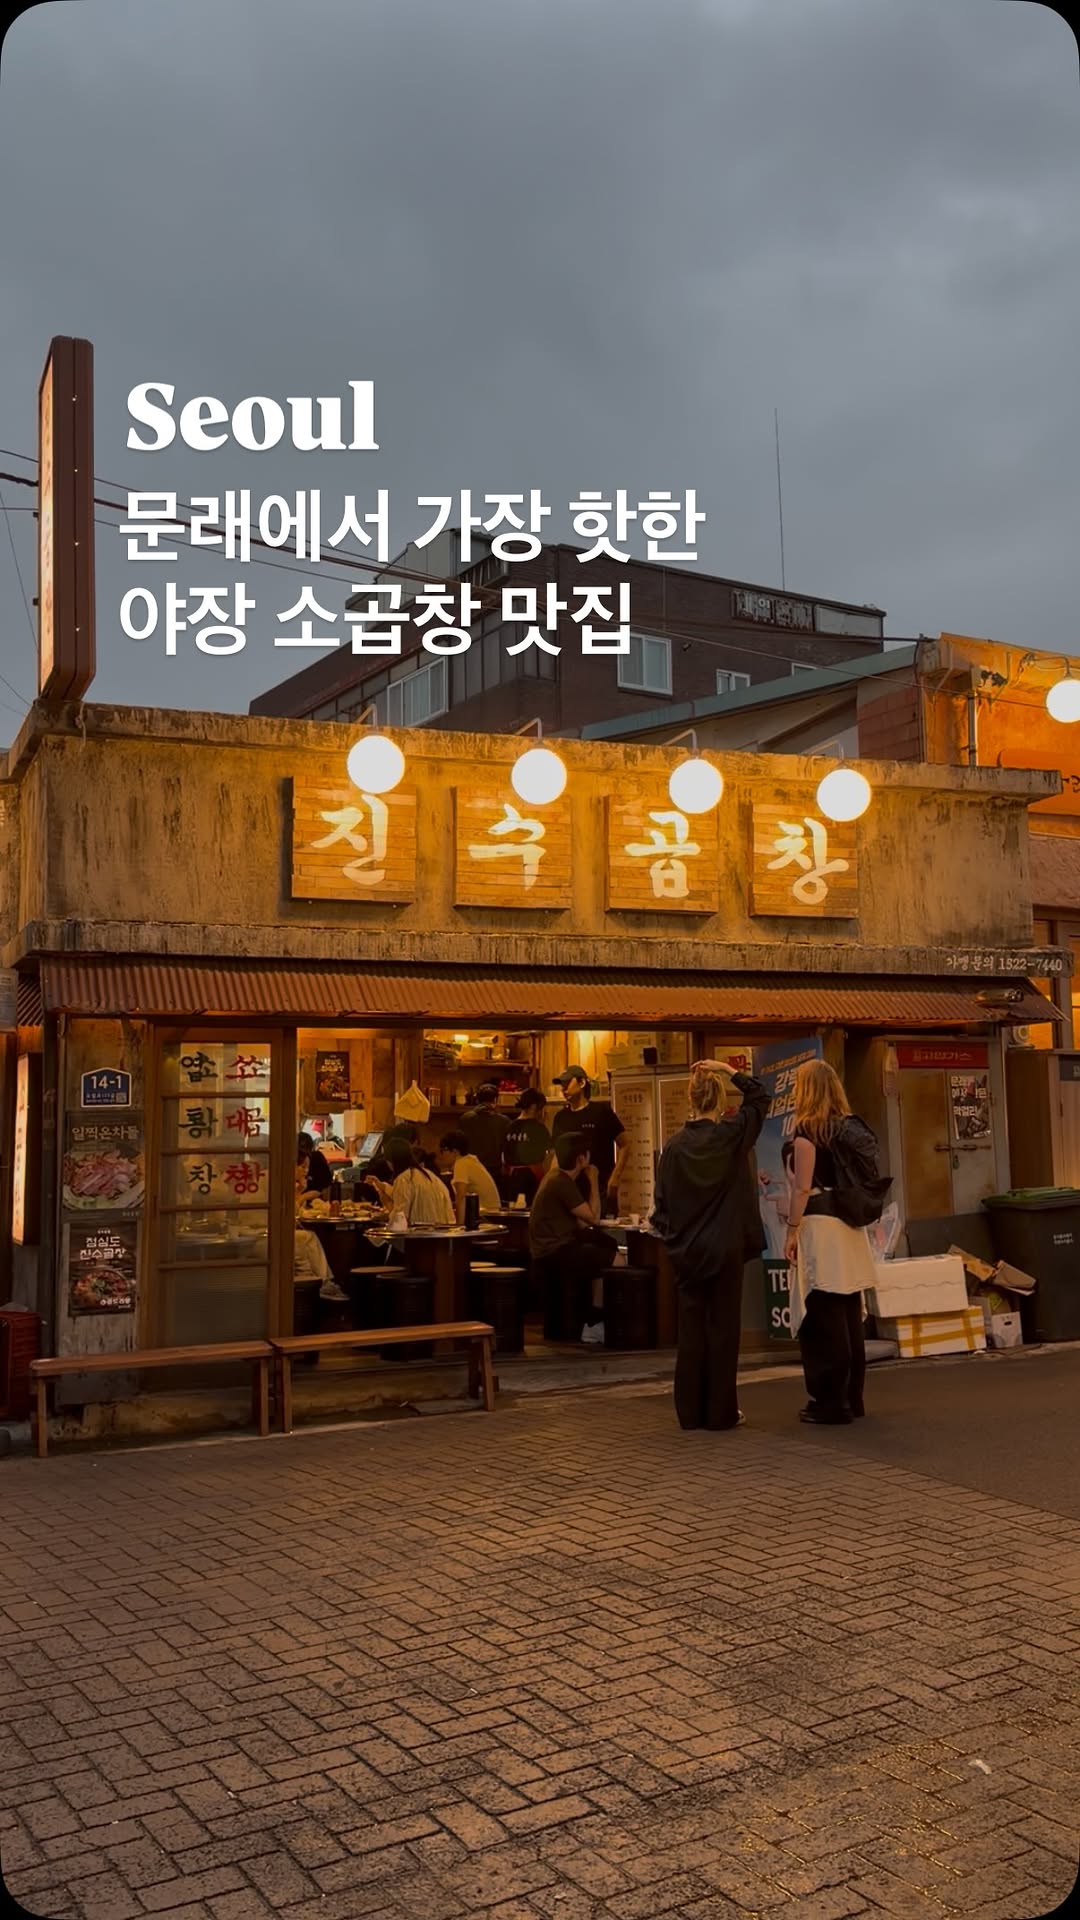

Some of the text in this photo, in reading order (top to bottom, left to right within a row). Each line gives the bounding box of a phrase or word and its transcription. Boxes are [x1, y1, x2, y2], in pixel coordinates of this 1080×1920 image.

[998, 957, 1063, 972] 1522-7440
[91, 1074, 122, 1090] 14-1
[85, 1236, 121, 1248] 점심도
